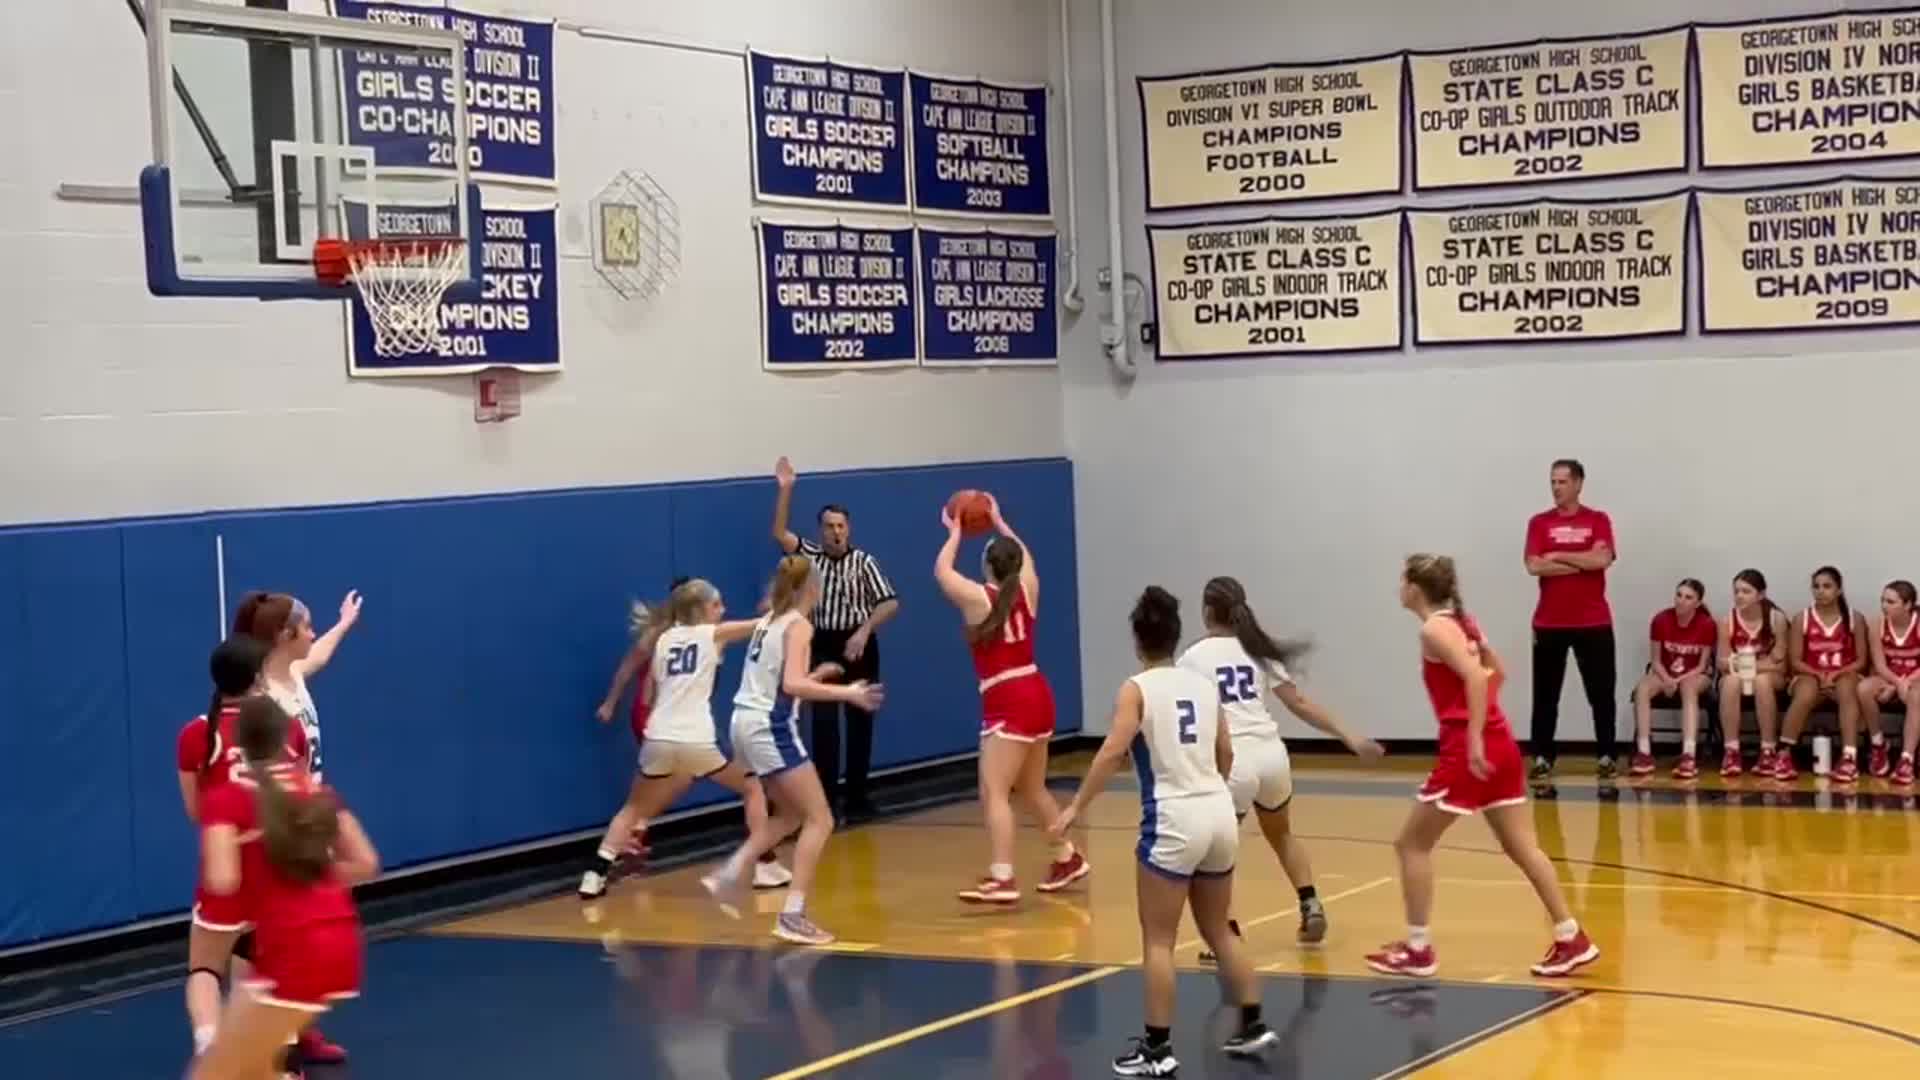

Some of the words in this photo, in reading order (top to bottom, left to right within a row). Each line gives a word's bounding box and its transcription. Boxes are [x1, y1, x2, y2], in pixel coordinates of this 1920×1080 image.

[484, 23, 526, 47] SCHOOL
[1741, 23, 1838, 49] GEORGETOWN
[1848, 20, 1882, 39] HIGH
[1892, 18, 1920, 37] SCH
[474, 48, 520, 79] DIVISION
[527, 55, 540, 81] II
[1449, 52, 1540, 77] GEORGETOWN
[1549, 48, 1580, 67] HIGH
[1591, 44, 1646, 65] SCHOOL
[1745, 48, 1831, 77] DIVISION
[1844, 46, 1865, 69] IV
[1879, 42, 1920, 66] NOR
[357, 70, 433, 101] GIRLS
[773, 64, 826, 84] GEORGETOWN
[831, 69, 849, 90] HIGH
[853, 74, 884, 95] SCHOOL
[1180, 77, 1267, 103] GEORGETOWN
[1274, 74, 1304, 94] HIGH
[1312, 71, 1363, 92] SCHOOL
[1443, 77, 1523, 103] STATE
[1536, 69, 1625, 94] CLASS
[1637, 65, 1653, 87] C
[1739, 80, 1800, 105] GIRLS
[1812, 72, 1920, 100] BASKETB
[764, 86, 787, 111] CAPE
[812, 91, 845, 117] LEAGUE
[849, 95, 882, 121] DIVISION
[999, 90, 1028, 110] SCHOOL
[1167, 106, 1233, 127] DIVISION
[1241, 103, 1259, 121] VI
[1268, 97, 1323, 119] SUPER
[1333, 94, 1378, 114] BOWL
[1421, 108, 1469, 132] CO-OP
[1479, 104, 1526, 129] GIRLS
[1535, 98, 1612, 123] OUTDOOR
[1623, 89, 1679, 116] TRACK
[358, 106, 541, 145] CO-CHAPIONS
[923, 104, 945, 128] CAPE
[964, 109, 994, 133] LEAGUE
[1752, 101, 1920, 133] CHAMPION
[765, 116, 818, 141] GIRLS
[824, 120, 896, 148] SOCCER
[1203, 122, 1342, 148] CHAMPIONS
[1459, 122, 1640, 156] CHAMPIONS
[1811, 131, 1888, 153] 2004
[428, 143, 482, 167] 200
[783, 144, 883, 173] CHAMPIONS
[936, 133, 1025, 160] SOFTBALL
[1207, 147, 1338, 172] FOOTBALL
[936, 158, 1029, 185] CHAMPIONS
[1514, 155, 1582, 176] 2002
[816, 175, 853, 193] 2001
[1239, 174, 1305, 193] 2000
[966, 188, 1002, 207] 2003
[1745, 189, 1843, 215] GEORGETOWN
[1852, 188, 1885, 206] HIGH
[1895, 187, 1920, 205] SCH
[377, 213, 451, 234] GEORGETOWN
[485, 217, 527, 239] SCHOOL
[1449, 210, 1540, 233] GEORGETOWN
[1548, 209, 1578, 227] HIGH
[1588, 208, 1643, 226] SCHOOL
[1749, 215, 1835, 242] DIVISION
[1848, 213, 1868, 235] IV
[1881, 211, 1920, 233] NOR
[783, 230, 837, 250] GEORGETOWN
[840, 231, 859, 251] HIGH
[863, 234, 894, 252] SCHOOL
[939, 238, 987, 257] GEORGETOWN
[1009, 241, 1036, 258] SCHOOL
[1187, 227, 1269, 250] GEORGETOWN
[1275, 226, 1304, 245] HIGH
[1312, 225, 1362, 245] SCHOOL
[1444, 235, 1523, 259] STATE
[1536, 232, 1625, 255] CLASS
[1636, 230, 1654, 250] C
[530, 243, 541, 268] II
[774, 254, 797, 278] CAPE
[822, 256, 855, 278] LEAGUE
[860, 257, 893, 279] DIVISION
[1183, 252, 1256, 275] STATE
[1267, 248, 1347, 270] CLASS
[1355, 246, 1371, 266] C
[1742, 247, 1803, 271] GIRLS
[1815, 240, 1920, 266] BASKETB
[931, 258, 952, 281] CAPE
[973, 260, 1003, 282] LEAGUE
[1426, 266, 1477, 287] CO-OP
[1489, 262, 1536, 285] GIRLS
[1546, 260, 1605, 282] INDOOR
[1617, 255, 1672, 279] TRACK
[1756, 269, 1920, 298] CHAMPION
[482, 274, 543, 299] CKEY
[777, 283, 830, 307] GIRLS
[835, 284, 909, 307] SOCCER
[935, 284, 973, 307] GIRLS
[976, 285, 1045, 308] LACROSSE
[1168, 279, 1213, 301] CO-OP
[1222, 275, 1266, 298] GIRLS
[1273, 273, 1328, 296] INDOOR
[1338, 269, 1388, 292] TRACK
[1195, 298, 1359, 324] CHAMPIONS
[1459, 286, 1640, 312] CHAMPIONS
[1816, 298, 1888, 319] 2009
[792, 311, 894, 335] CHAMPIONS
[947, 310, 1034, 332] CHAMPIONS
[1514, 316, 1583, 334] 2002
[438, 336, 487, 356] 2001
[825, 340, 864, 358] 2002
[1248, 326, 1306, 345] 2001
[667, 643, 699, 677] 20
[1215, 665, 1258, 704] 22
[1175, 700, 1197, 744] 2
